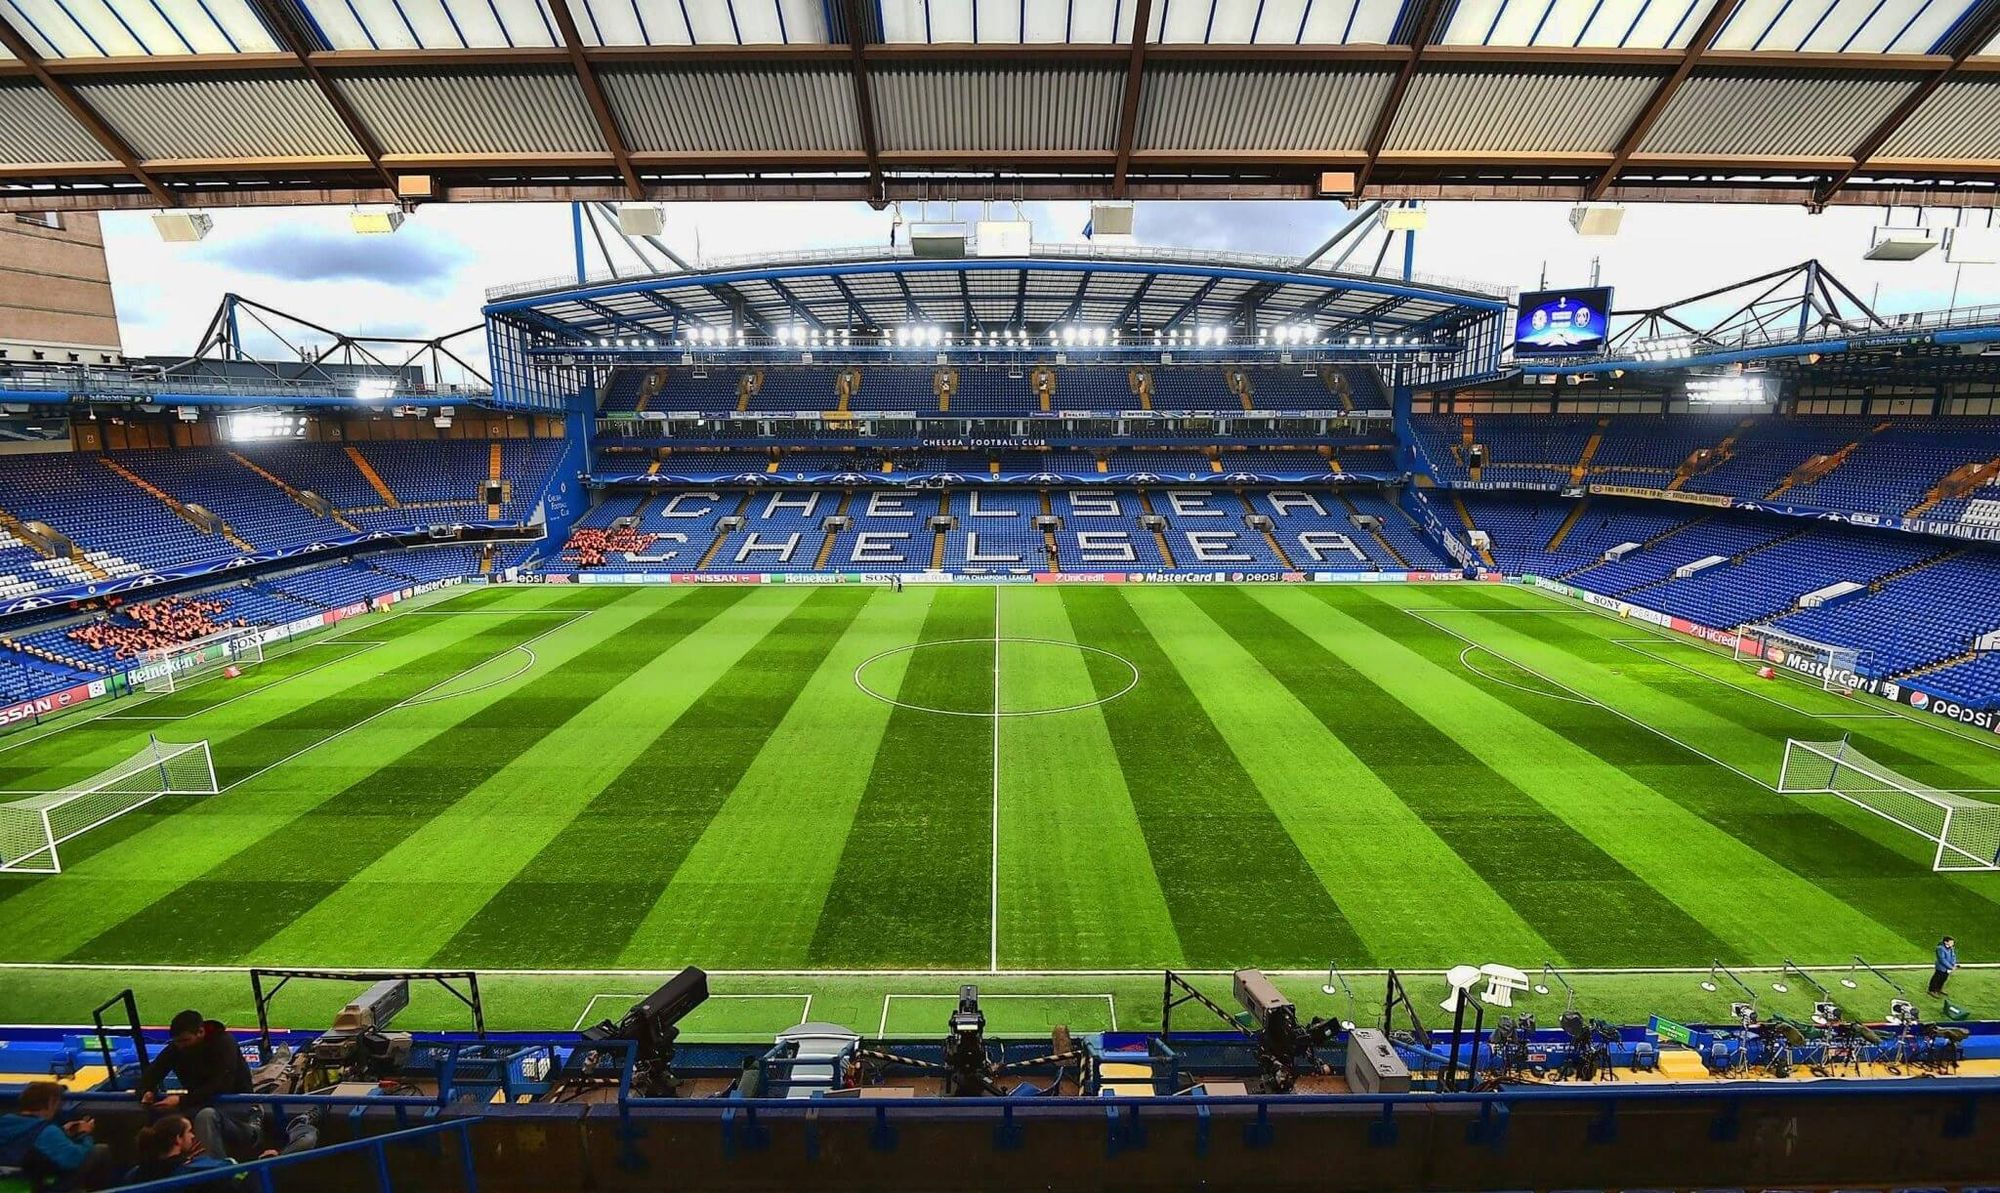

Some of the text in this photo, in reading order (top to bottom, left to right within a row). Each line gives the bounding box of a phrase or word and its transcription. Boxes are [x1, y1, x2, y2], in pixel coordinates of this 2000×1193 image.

[661, 490, 1328, 518] CHELSEA
[623, 531, 1368, 562] CHELSEA
[516, 573, 543, 584] epsi
[694, 573, 738, 583] NISSAN
[785, 573, 836, 583] Heineken
[953, 574, 1032, 582] UEFA CHAMPIONS LEAGUE
[1063, 573, 1105, 582] UniCredit
[1145, 572, 1212, 582] MasterCard
[1246, 572, 1278, 583] pepsi
[1430, 573, 1463, 581] NISSA
[413, 575, 462, 596] MasterCard
[1534, 575, 1568, 596] Heineken
[1593, 595, 1621, 609] SONY
[1786, 653, 1878, 693] MasterCard
[1932, 700, 1993, 728] pepsi
